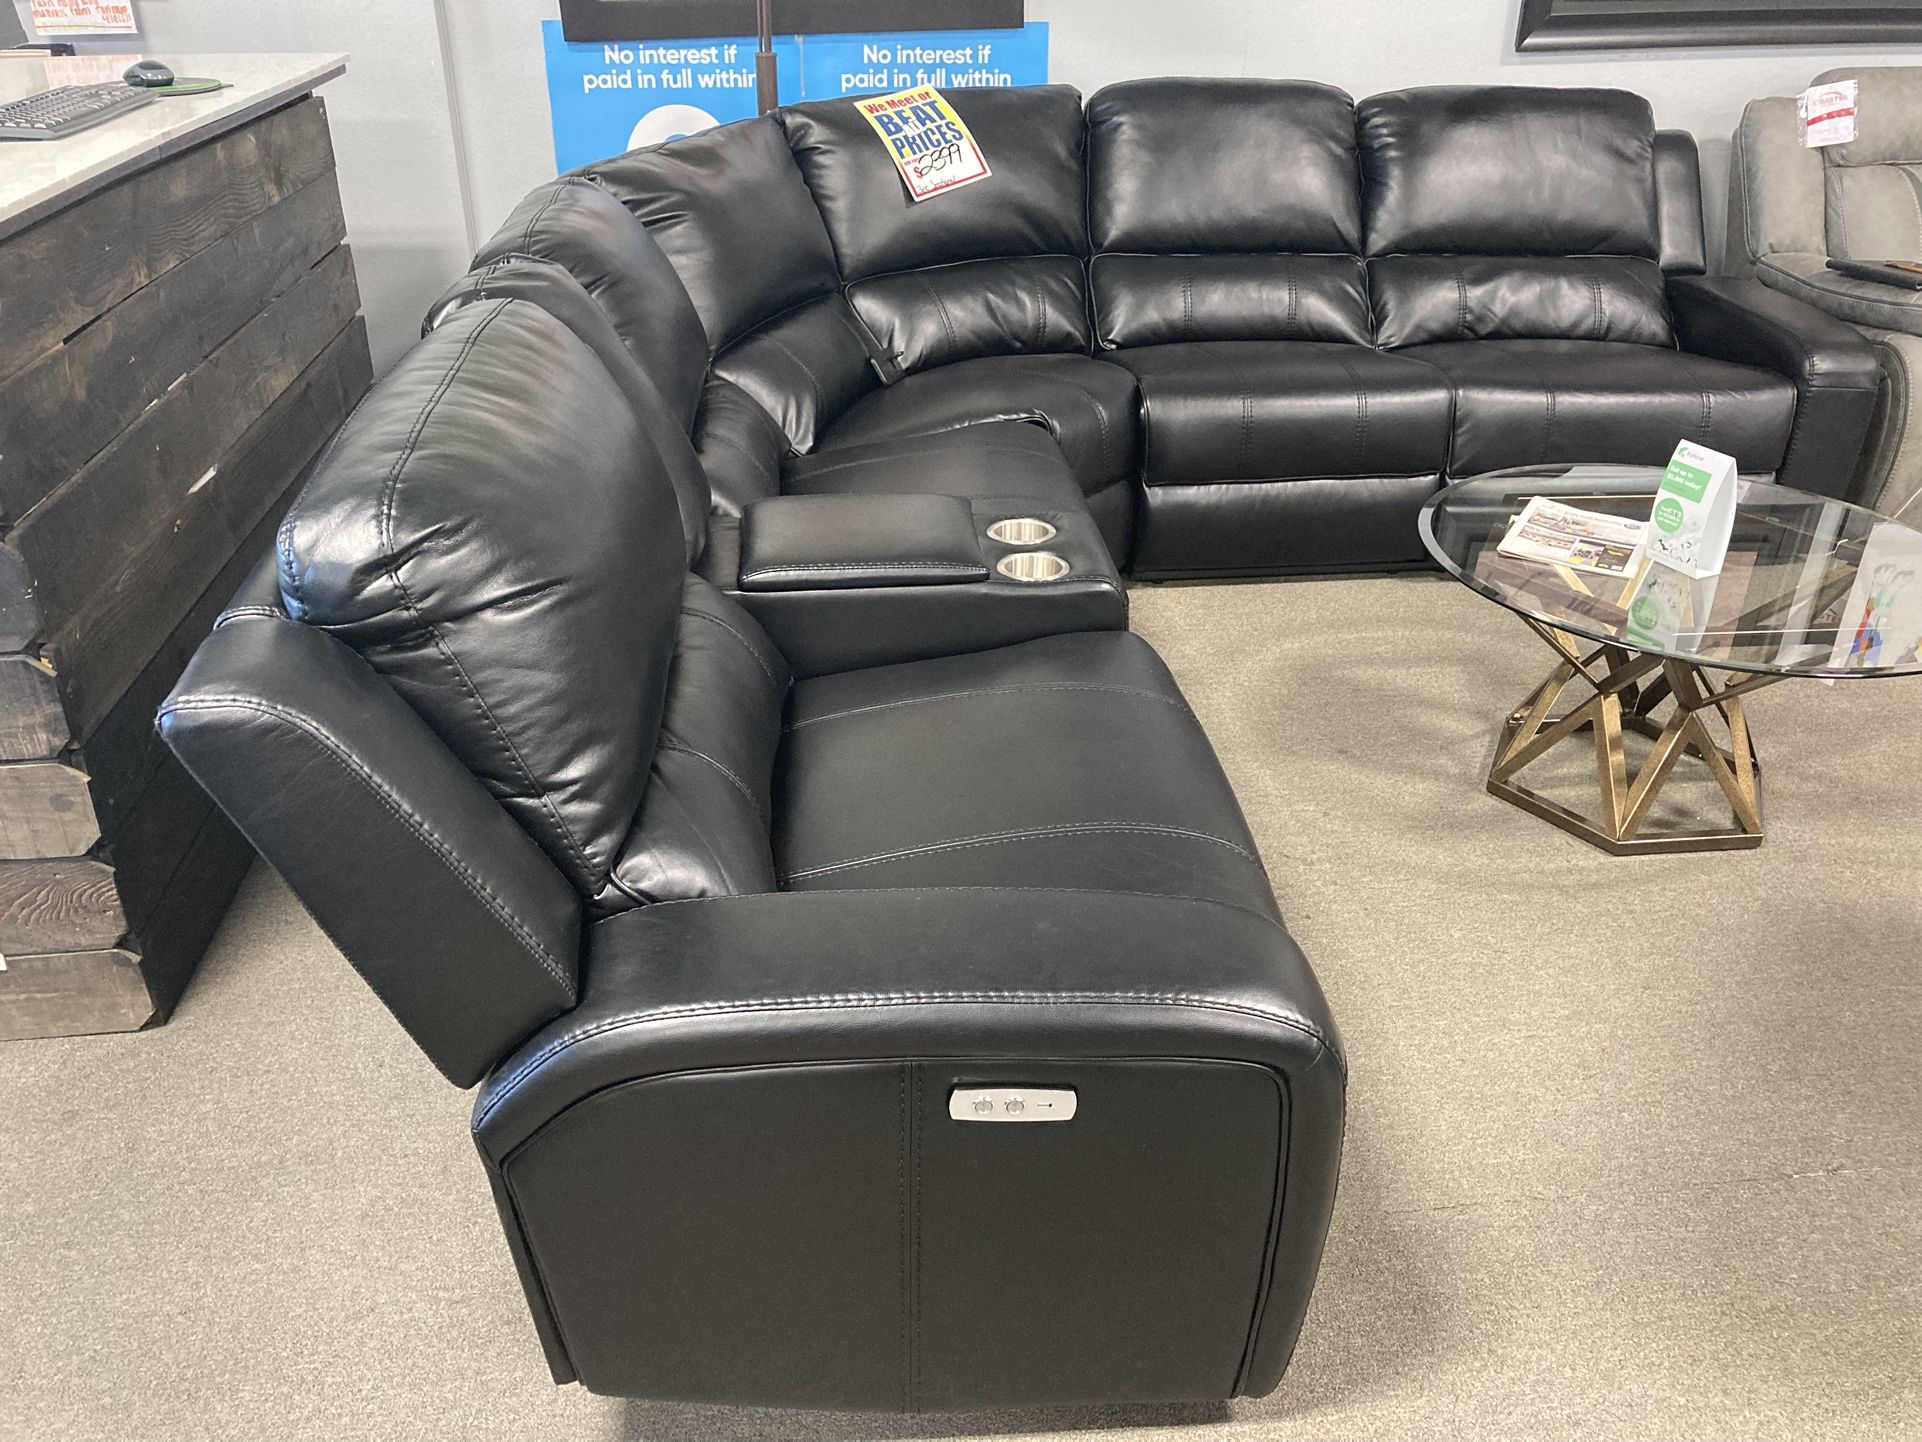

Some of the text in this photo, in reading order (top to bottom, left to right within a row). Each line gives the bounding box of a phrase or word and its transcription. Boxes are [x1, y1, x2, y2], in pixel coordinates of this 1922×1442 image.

[603, 44, 738, 65] No interest if
[863, 44, 992, 64] No interest if
[583, 69, 633, 94] paid
[637, 69, 657, 89] in
[661, 68, 693, 89] full
[841, 68, 1012, 93] paid in full within
[864, 102, 887, 115] We
[886, 95, 917, 110] Meet
[874, 100, 947, 136] BEAT
[891, 121, 964, 160] PRICES
